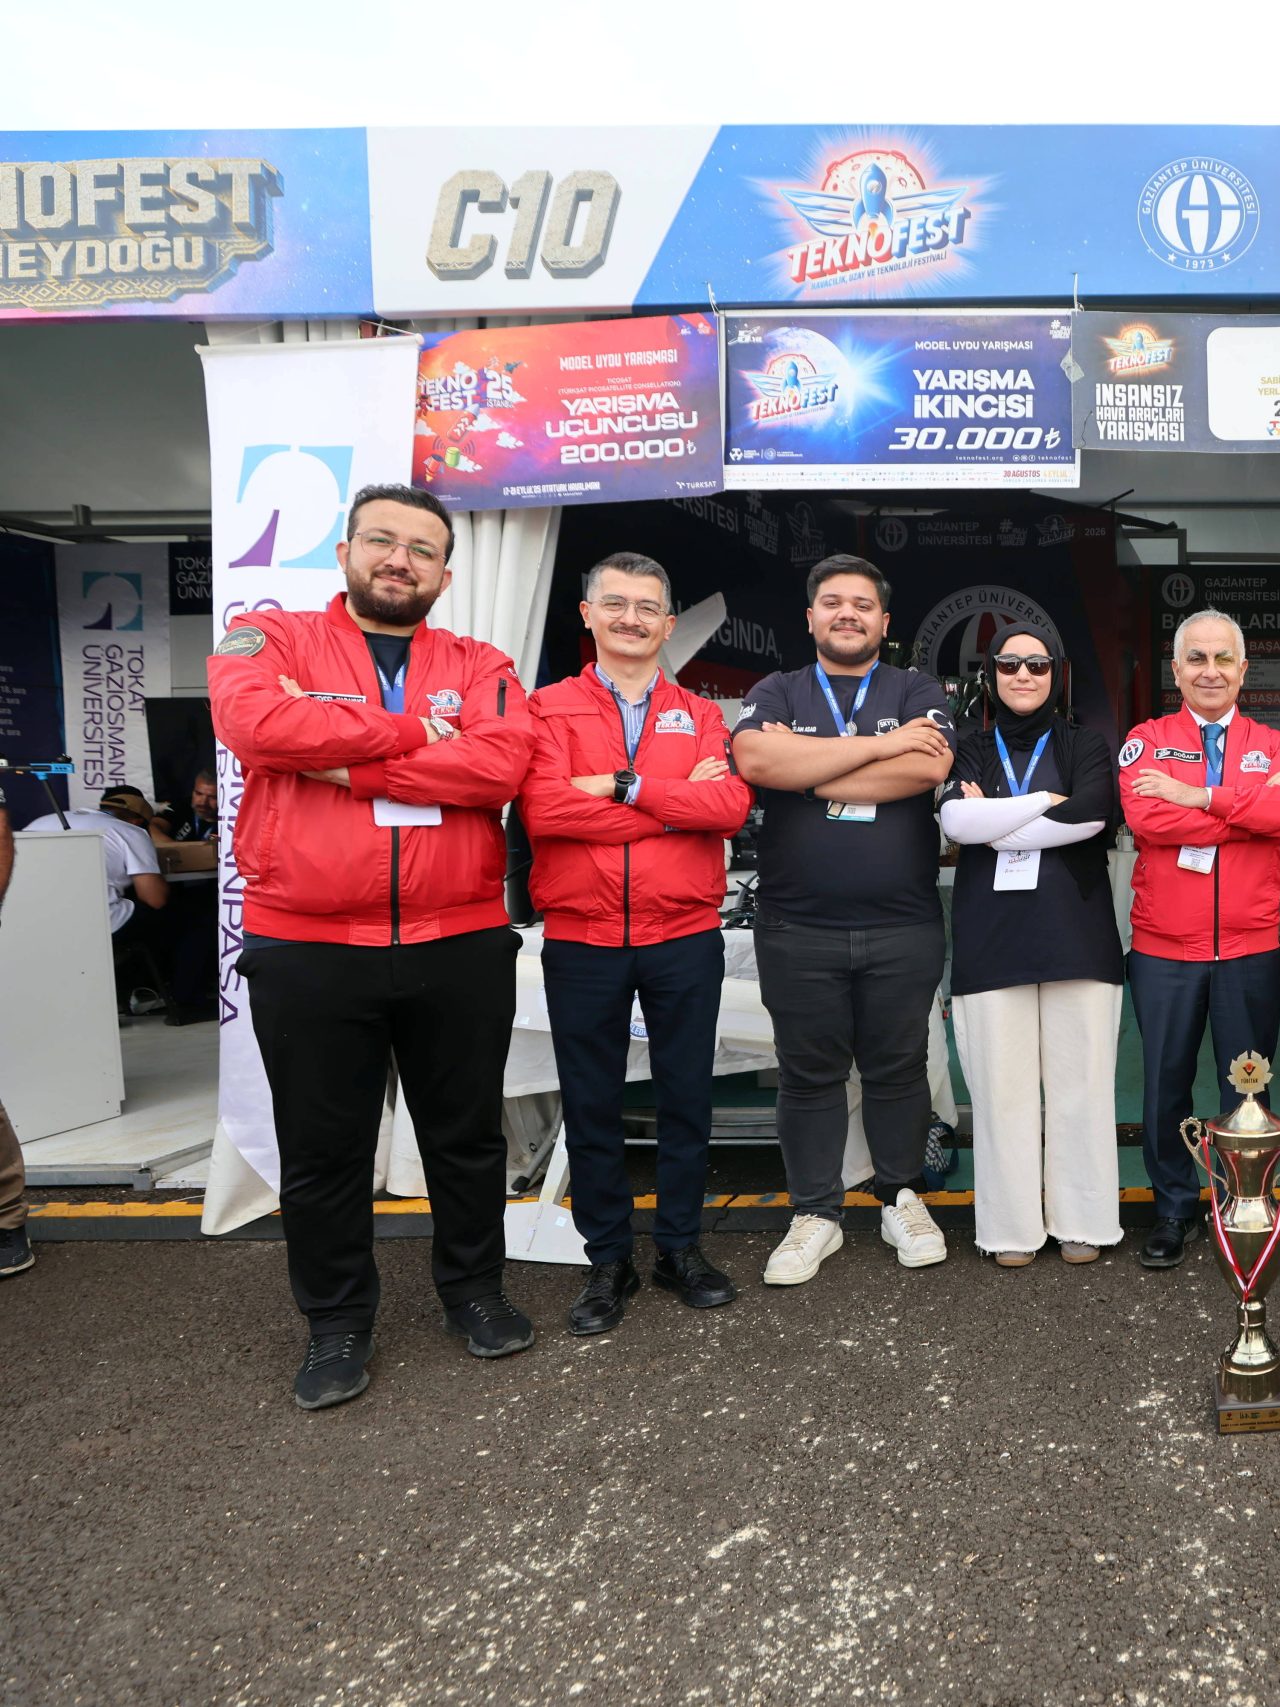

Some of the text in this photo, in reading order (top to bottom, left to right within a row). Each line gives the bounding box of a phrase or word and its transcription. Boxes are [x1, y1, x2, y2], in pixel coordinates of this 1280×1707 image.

[1142, 159, 1258, 215] GAZİANTEP ÜNİVERSİTESİ
[424, 170, 622, 281] C10
[0, 230, 206, 279] EYDOĞU
[788, 207, 971, 282] TEKNOFEST
[849, 270, 865, 282] UZAY
[865, 267, 875, 277] VE
[876, 259, 913, 276] TEKNOLOJİ
[914, 252, 947, 268] FESTİVALİ
[1185, 258, 1214, 270] 1973
[915, 341, 1034, 352] MODEL UYDU YARIŞMASI
[560, 349, 678, 371] MODEL UYDU YARIŞMASI
[1109, 348, 1173, 372] TEKNOFEST
[484, 368, 515, 400] 25
[912, 368, 1035, 392] YARIŞMA
[430, 389, 477, 411] FEST
[561, 391, 680, 416] YARIŞMA
[751, 384, 839, 420] TEKNOFEST
[1096, 406, 1126, 420] HAVA
[1096, 420, 1185, 442] YARIŞMASI
[918, 520, 980, 532] GAZİANTEP
[1085, 527, 1107, 536] 2026
[918, 533, 993, 546] ÜNİVERSİTESİ
[1204, 576, 1268, 588] GAZİANTEP
[1204, 590, 1280, 601] ÜNİVERSİTESİ
[920, 594, 972, 666] GAZİANTEP
[128, 644, 146, 717] TOKAT
[1164, 695, 1183, 704] 202
[82, 643, 105, 791] ÜNİVERSİTESİ
